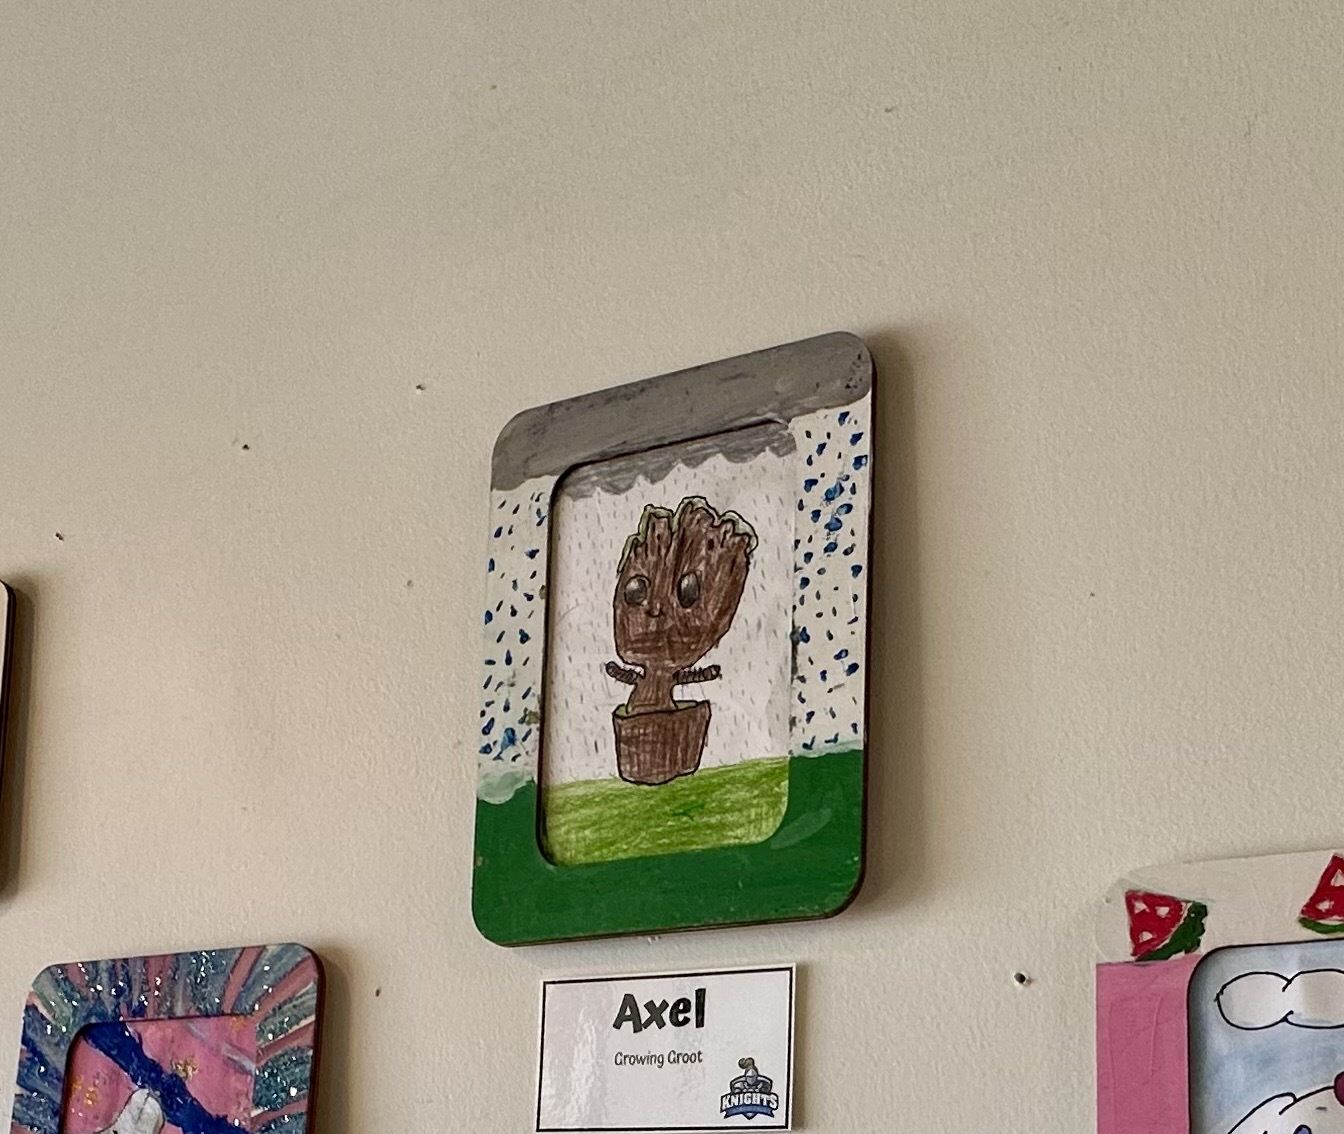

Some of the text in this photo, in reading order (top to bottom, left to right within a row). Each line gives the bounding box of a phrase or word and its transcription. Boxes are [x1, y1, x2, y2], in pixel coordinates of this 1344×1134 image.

[613, 988, 706, 1034] Axel
[614, 1049, 704, 1068] Growing Groot
[722, 1092, 778, 1111] KNIGHTS
